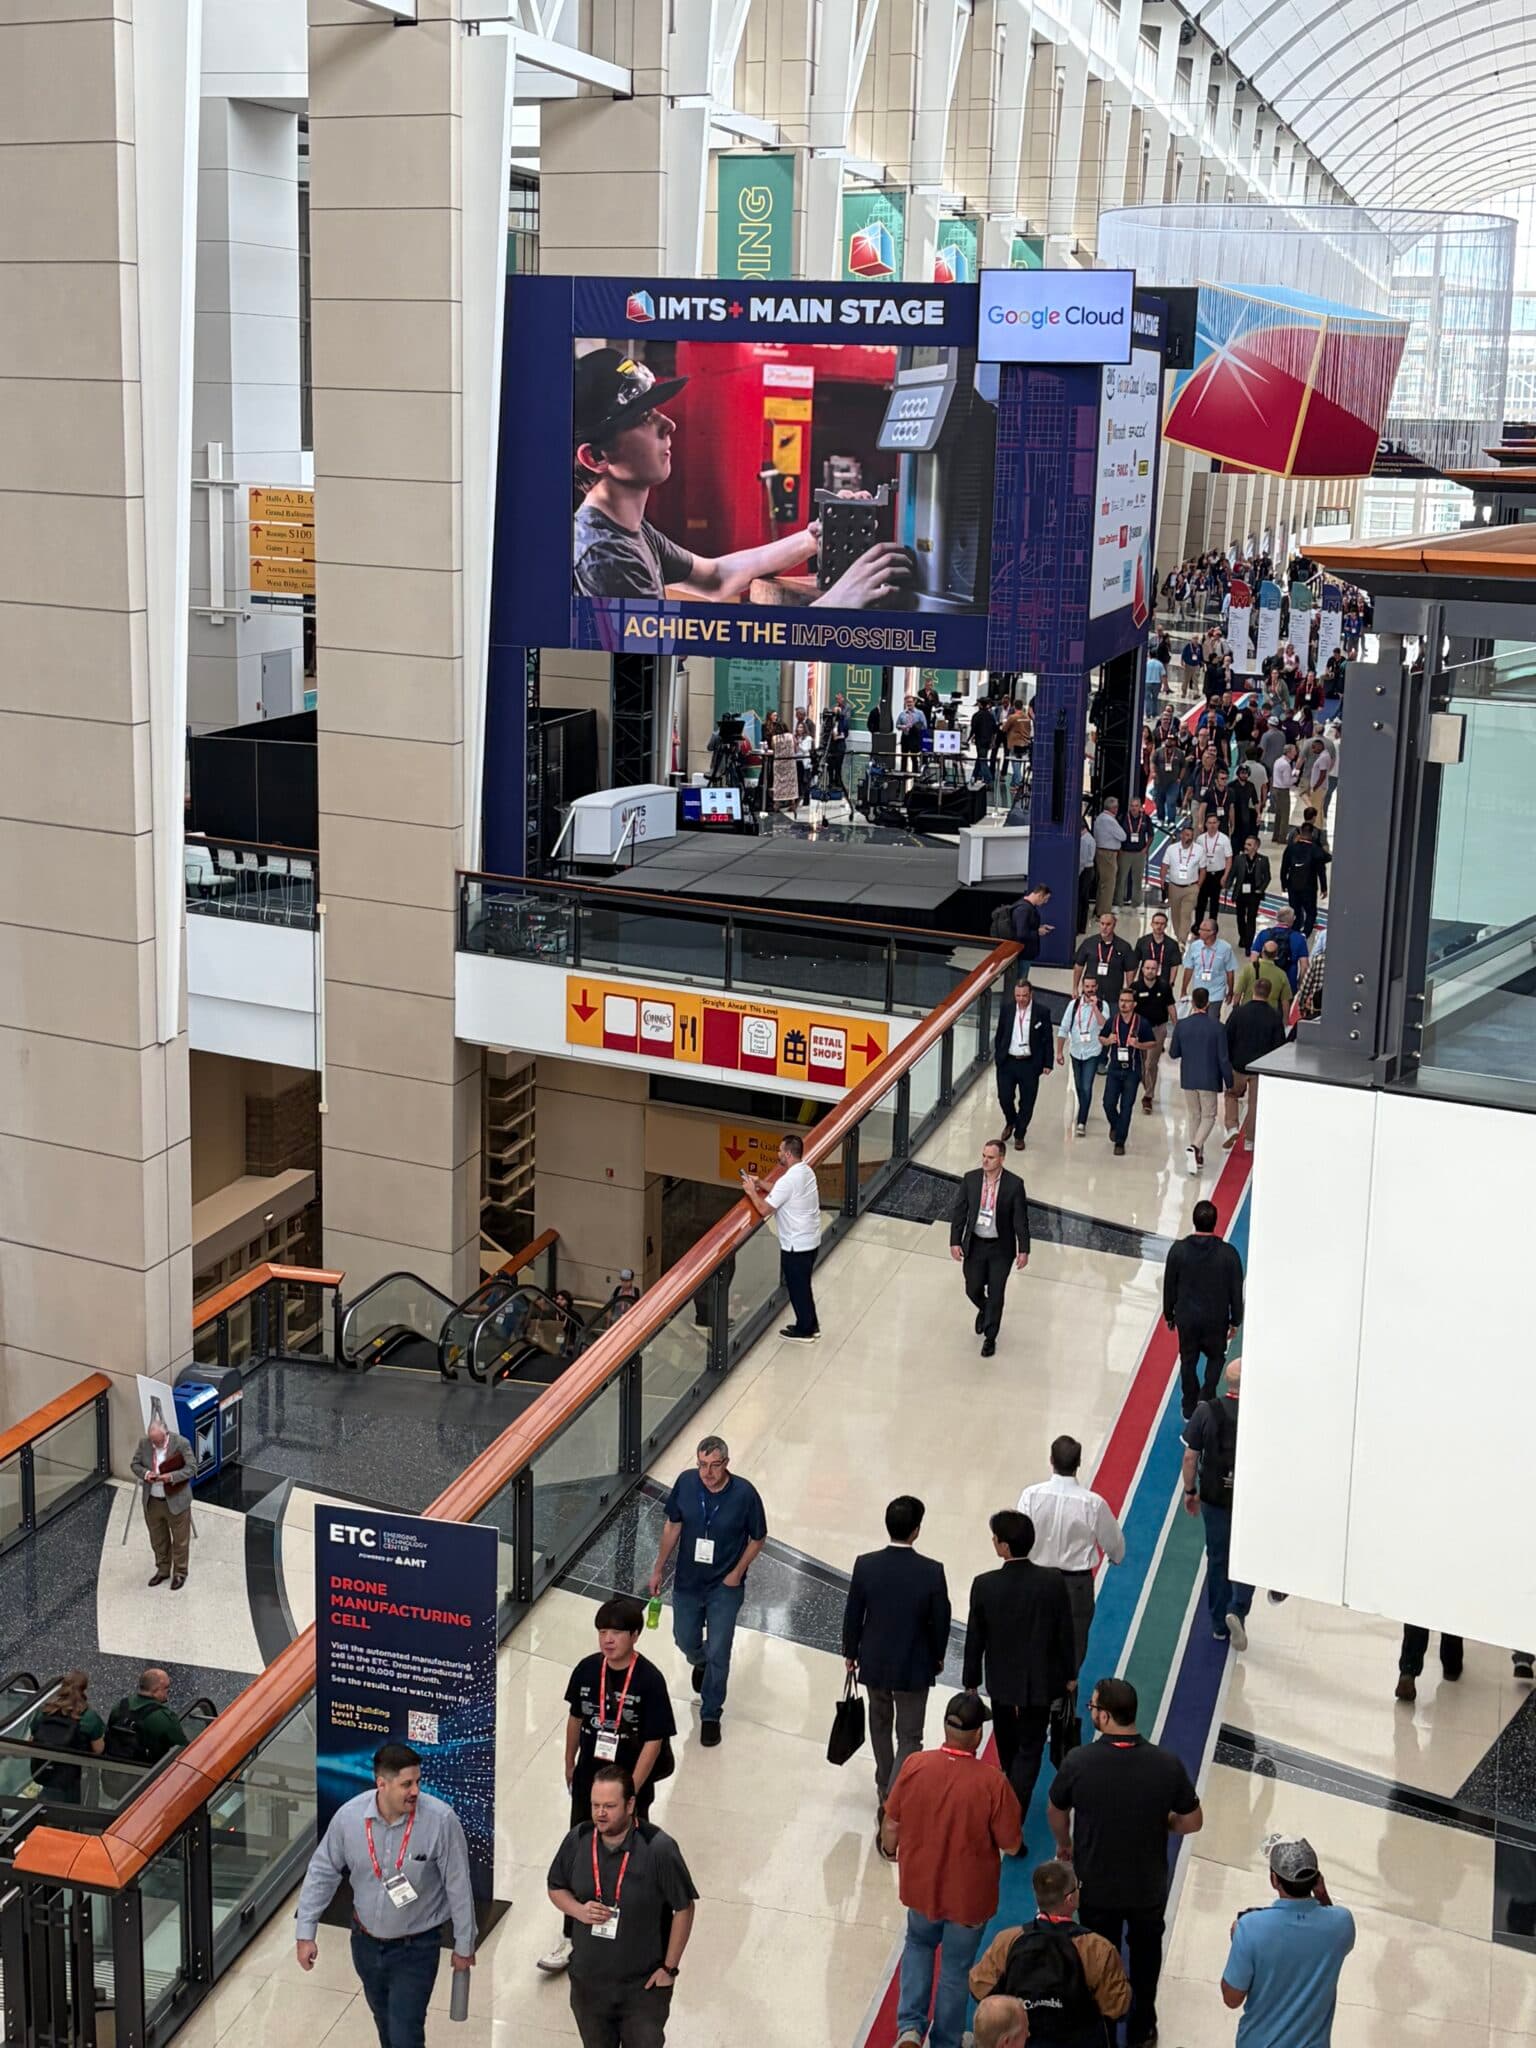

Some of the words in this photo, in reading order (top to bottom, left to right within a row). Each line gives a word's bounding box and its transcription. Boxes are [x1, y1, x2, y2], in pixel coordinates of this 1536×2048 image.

[738, 186, 773, 280] ING
[750, 298, 832, 324] MAIN
[839, 298, 945, 326] STAGE
[988, 306, 1060, 330] Google
[1065, 306, 1124, 325] Cloud
[289, 529, 312, 538] S100
[624, 616, 731, 642] ACHIEVE
[736, 620, 787, 645] THE
[791, 624, 937, 652] IMPOSSIBLE
[702, 998, 726, 1008] Straight
[728, 1002, 746, 1010] Ahead
[750, 1004, 762, 1012] This
[763, 1007, 778, 1015] Level
[812, 1036, 842, 1048] RETAIL
[812, 1048, 842, 1060] SHOPS
[330, 1523, 376, 1548] ETC
[383, 1532, 418, 1542] EMERGING
[383, 1537, 428, 1549] TECHNOLOGY
[383, 1544, 410, 1552] CENTER
[330, 1576, 388, 1596] DRONE
[330, 1594, 472, 1628] MANUFACTURING
[330, 1612, 371, 1630] CELL
[330, 1651, 346, 1660] cell
[347, 1653, 355, 1661] in
[356, 1654, 370, 1664] the
[372, 1657, 390, 1667] ETC.
[392, 1660, 422, 1672] Drones
[422, 1666, 463, 1679] produced
[331, 1641, 348, 1651] Visit
[350, 1644, 364, 1654] the
[366, 1648, 410, 1661] automated
[412, 1656, 472, 1672] manufacturing
[338, 1662, 354, 1670] rate
[356, 1664, 365, 1672] of
[366, 1666, 395, 1678] 10,000
[396, 1672, 410, 1681] per
[412, 1674, 442, 1685] month.
[330, 1674, 346, 1683] See
[348, 1676, 362, 1686] the
[363, 1679, 390, 1691] results
[392, 1684, 408, 1694] and
[409, 1687, 434, 1698] watch
[436, 1692, 457, 1702] them
[331, 1700, 355, 1711] North
[331, 1709, 353, 1719] Level
[331, 1717, 356, 1728] Booth
